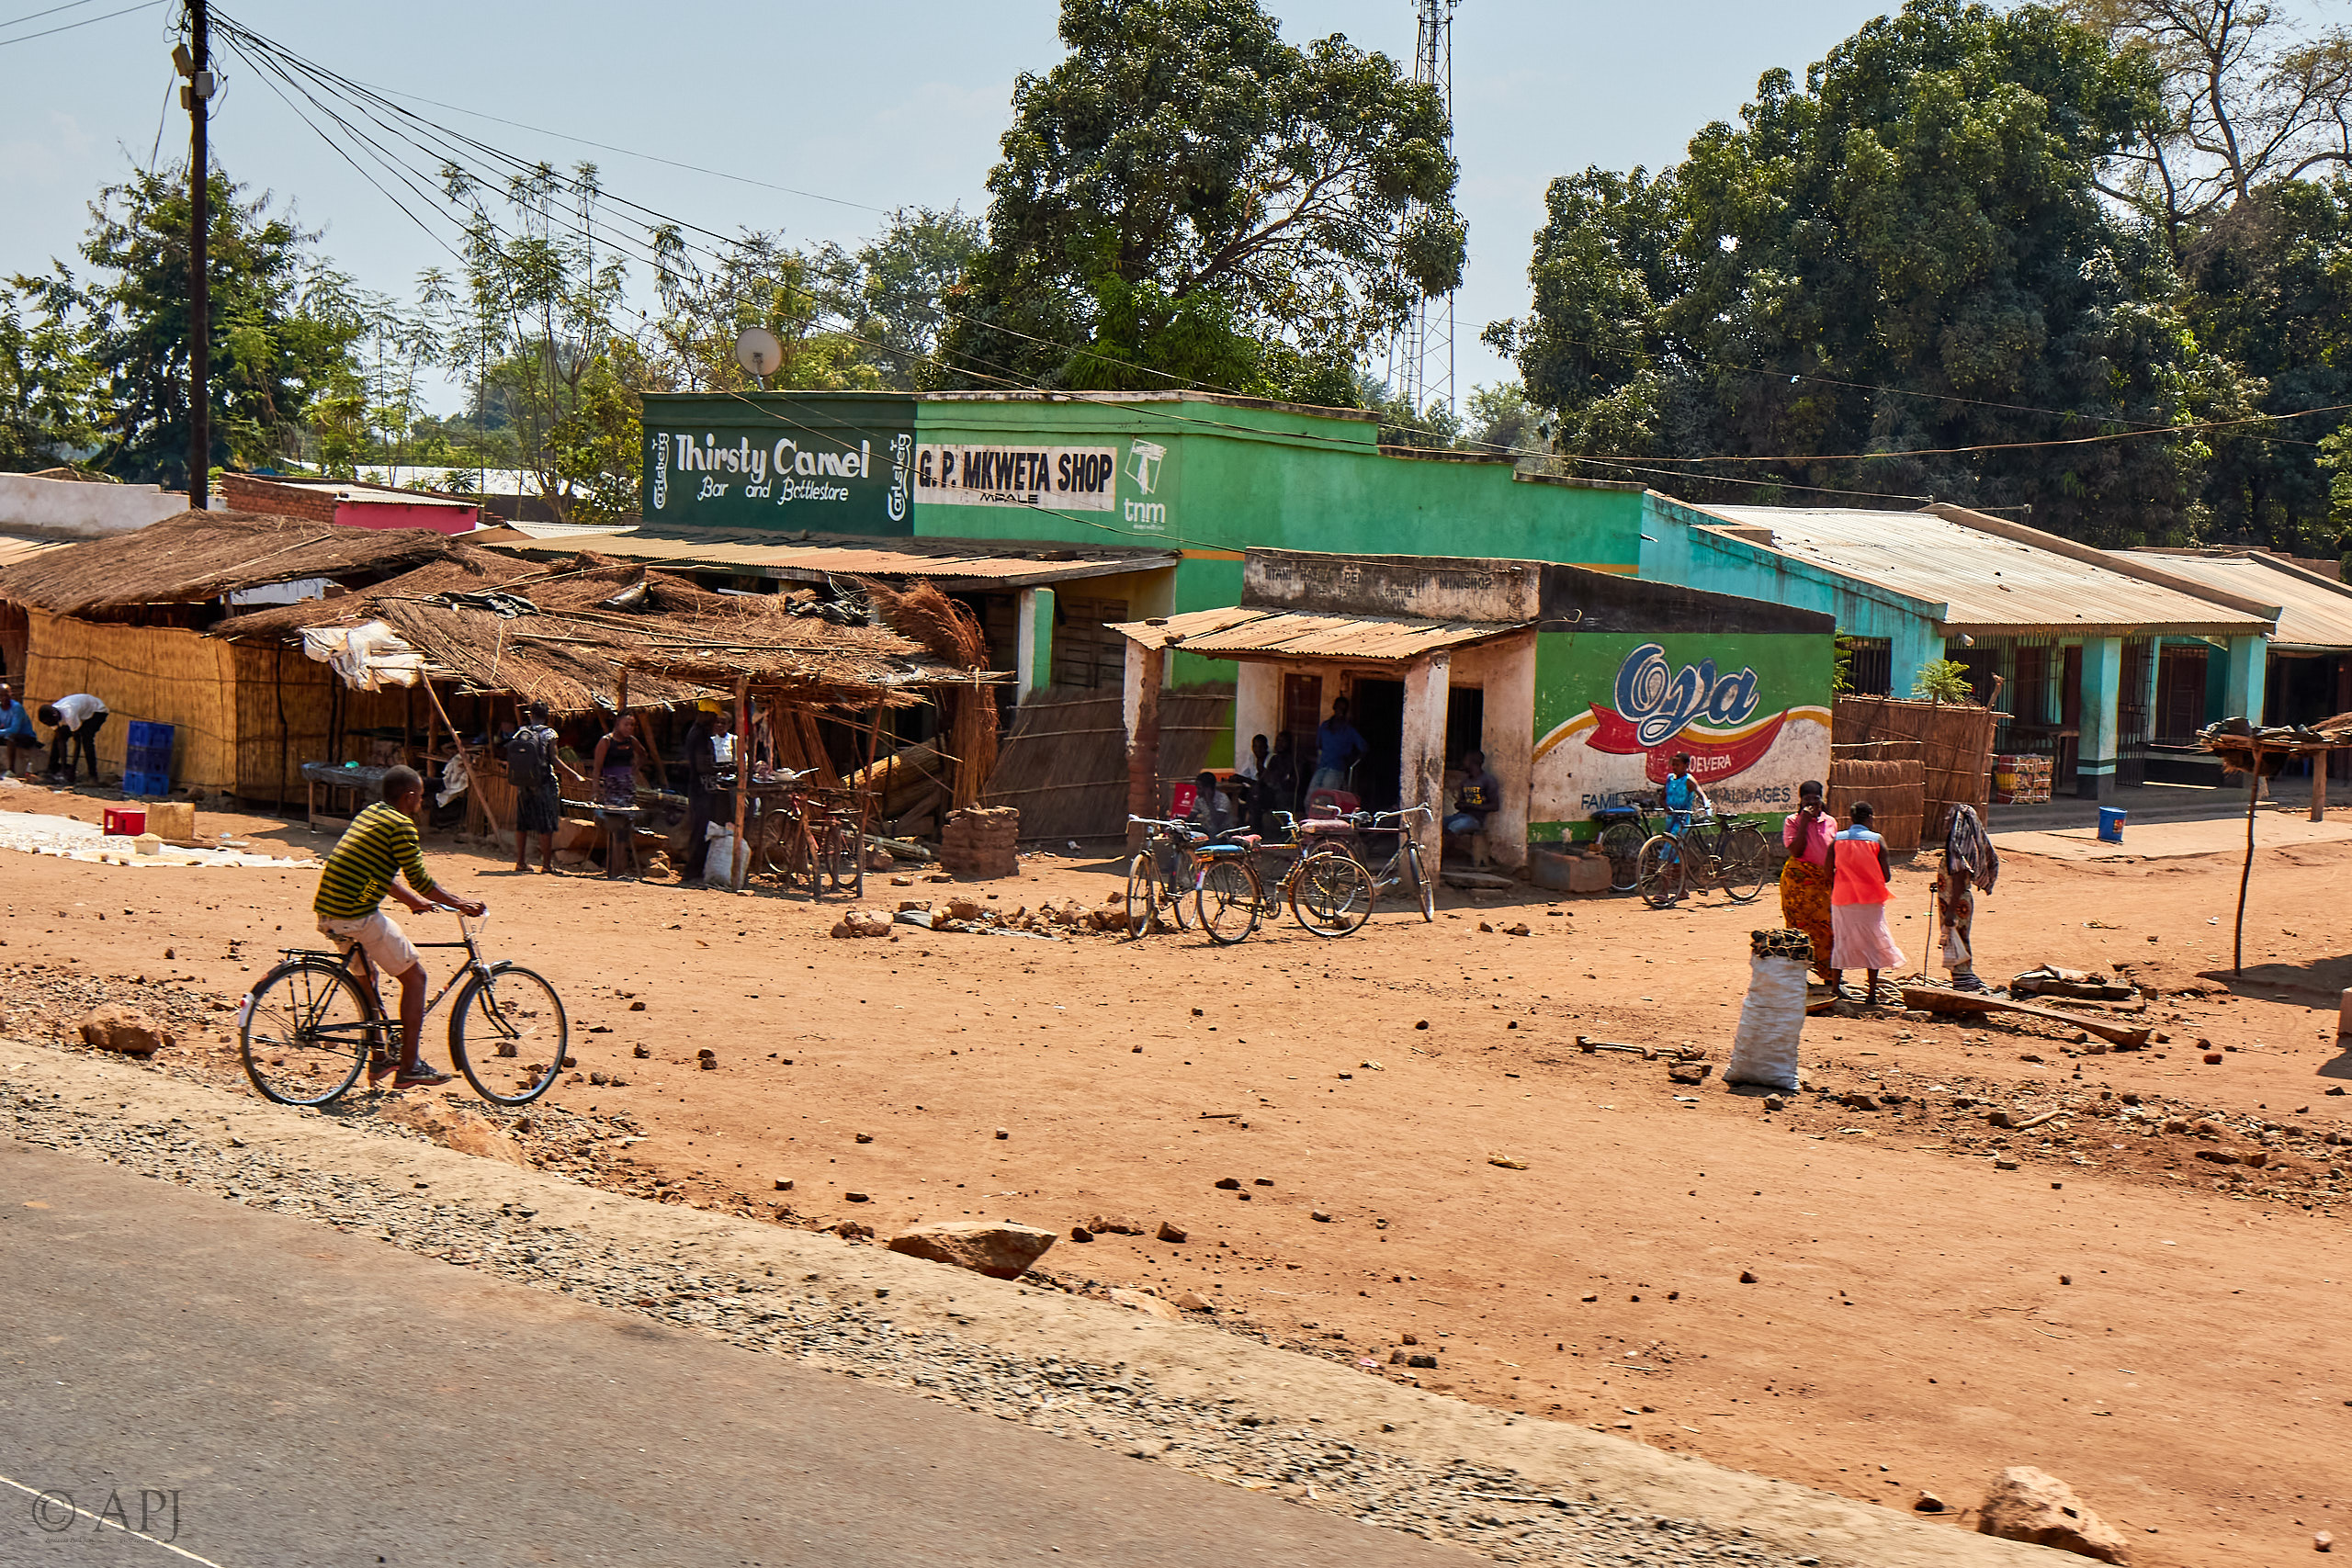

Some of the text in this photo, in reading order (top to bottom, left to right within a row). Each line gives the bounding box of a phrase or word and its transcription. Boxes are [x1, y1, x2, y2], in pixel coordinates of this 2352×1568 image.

[675, 433, 871, 484] Thirsty Camel
[964, 451, 1050, 491] MKWETA
[1057, 454, 1114, 493] SHOP
[696, 475, 729, 502] Bar
[745, 479, 772, 499] and
[1124, 498, 1166, 524] tnm
[1614, 643, 1760, 748] Oya
[1752, 787, 1791, 804] AGES
